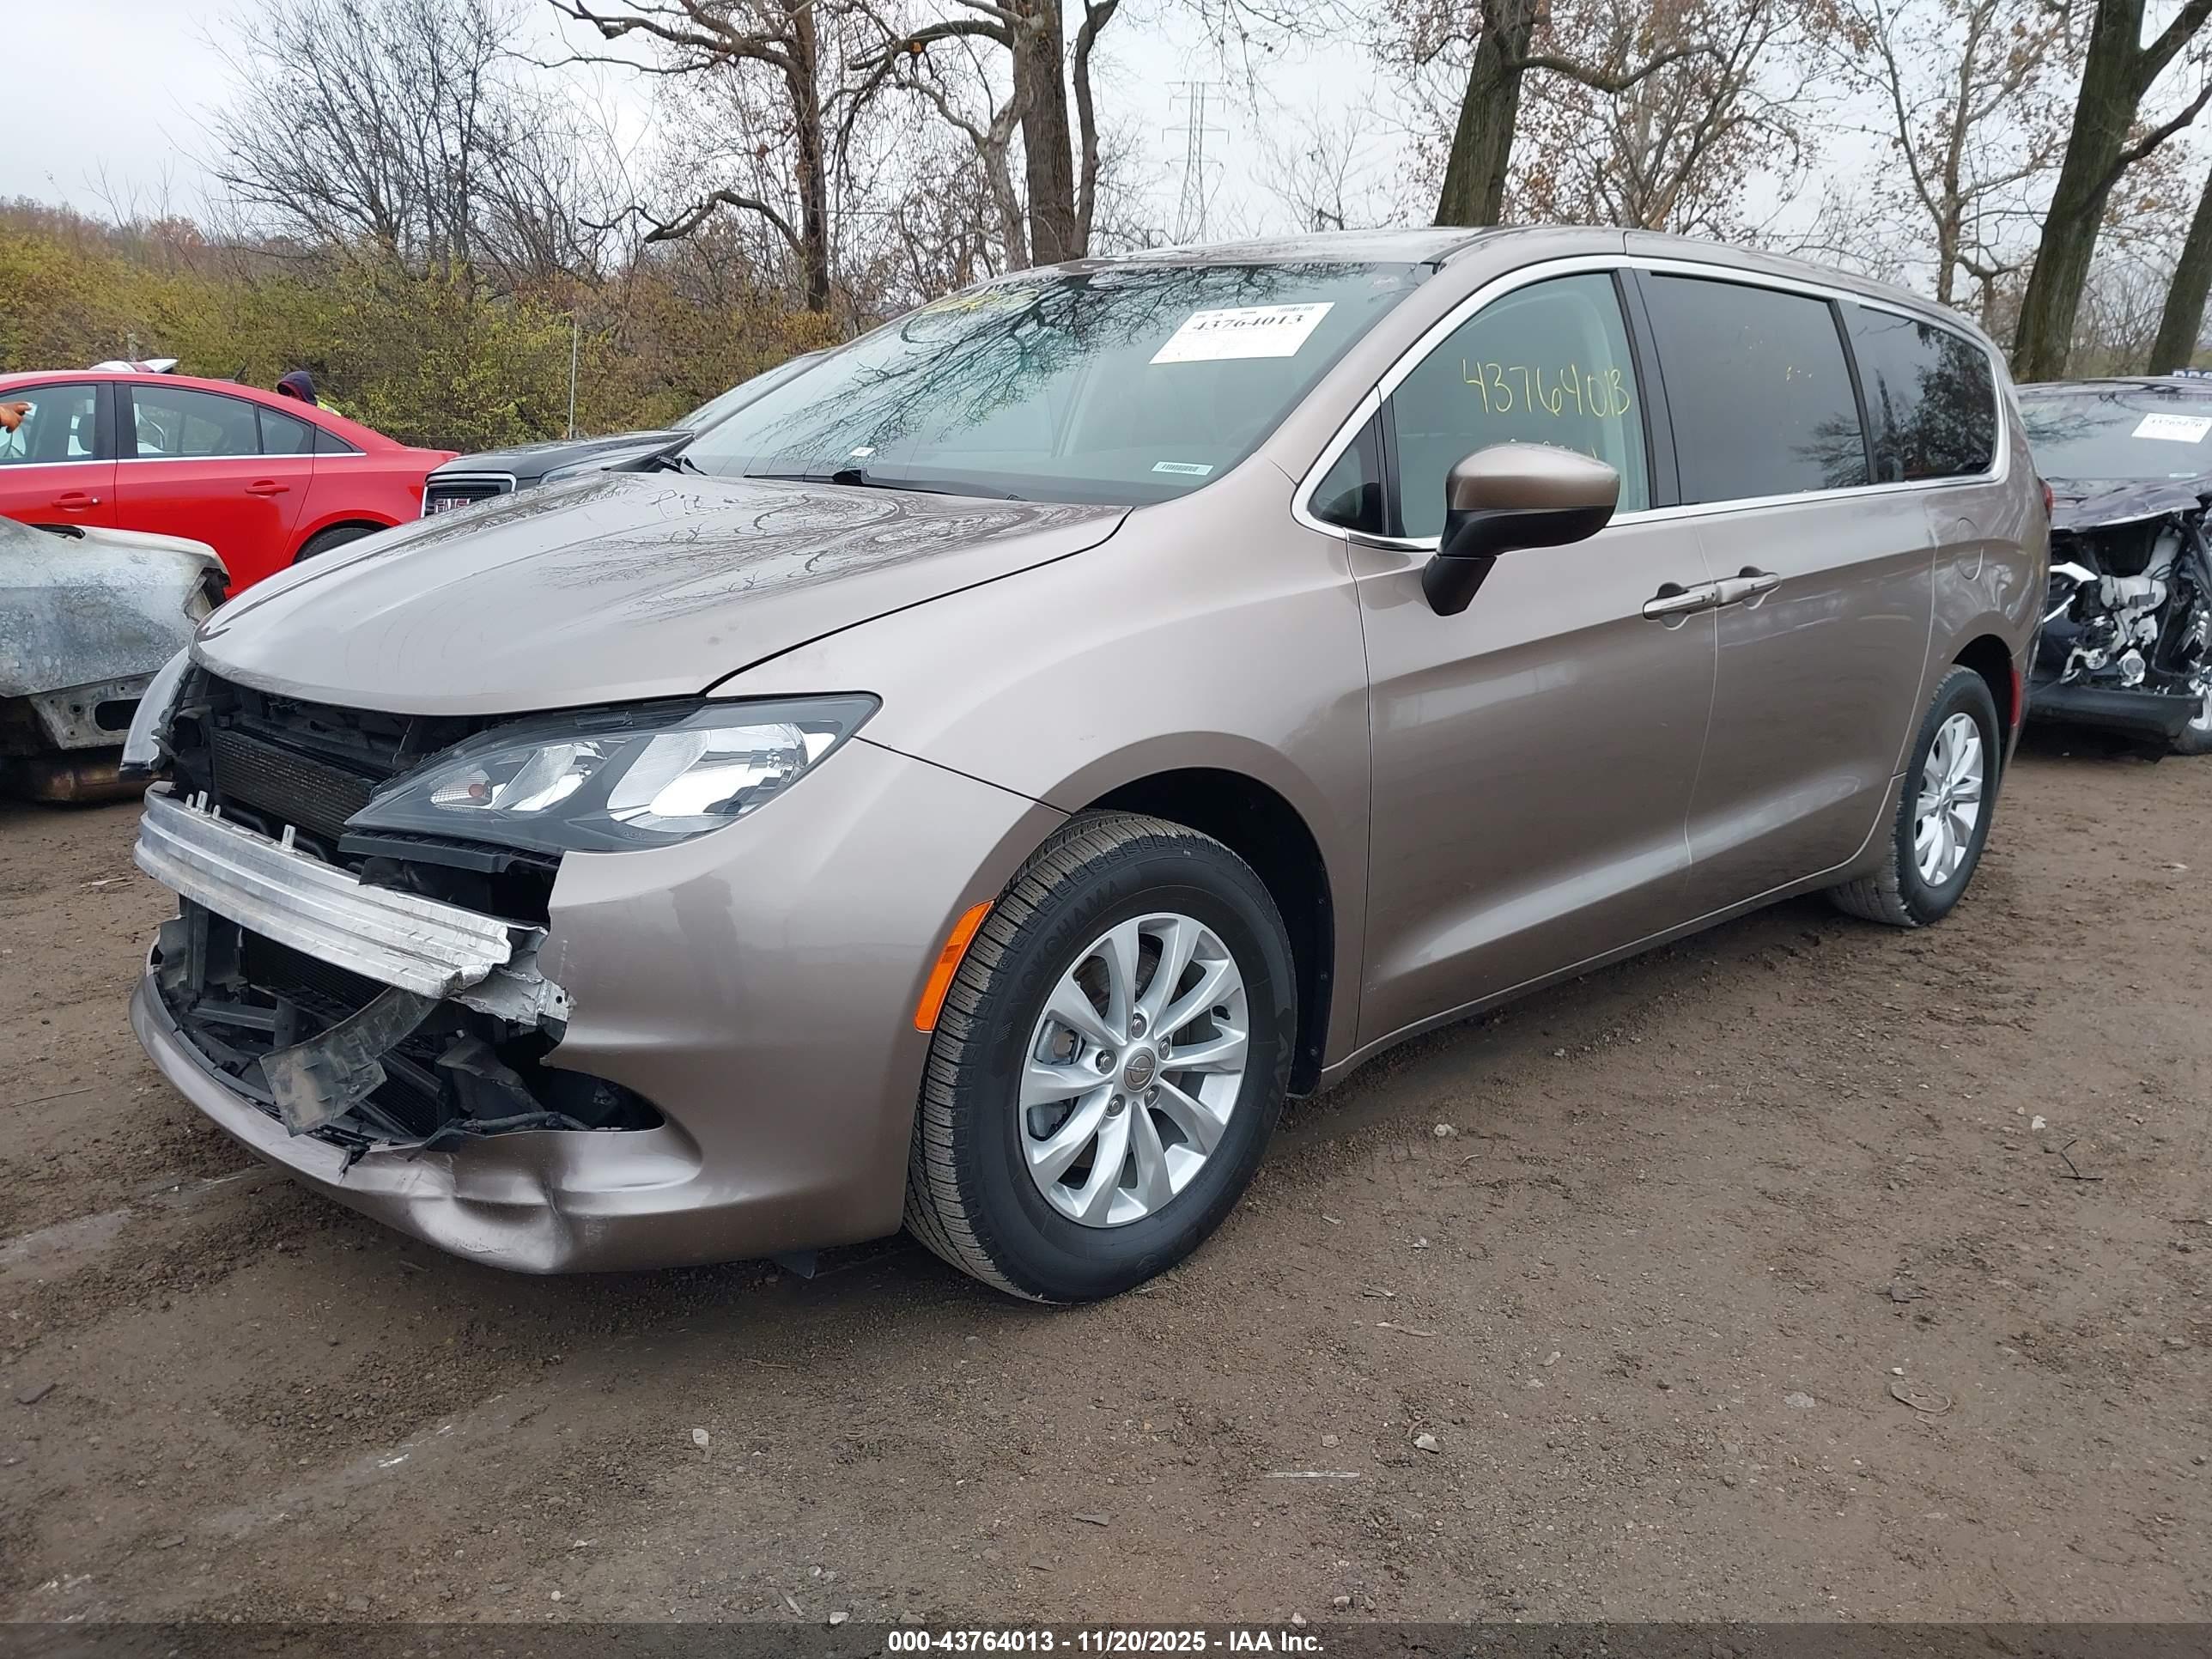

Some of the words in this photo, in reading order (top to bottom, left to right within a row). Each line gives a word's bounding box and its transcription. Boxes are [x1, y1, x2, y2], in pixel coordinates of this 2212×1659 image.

[1193, 314, 1304, 331] 43764013
[1461, 357, 1631, 417] 43764013
[1012, 879, 1120, 1012] YOKOHAMA
